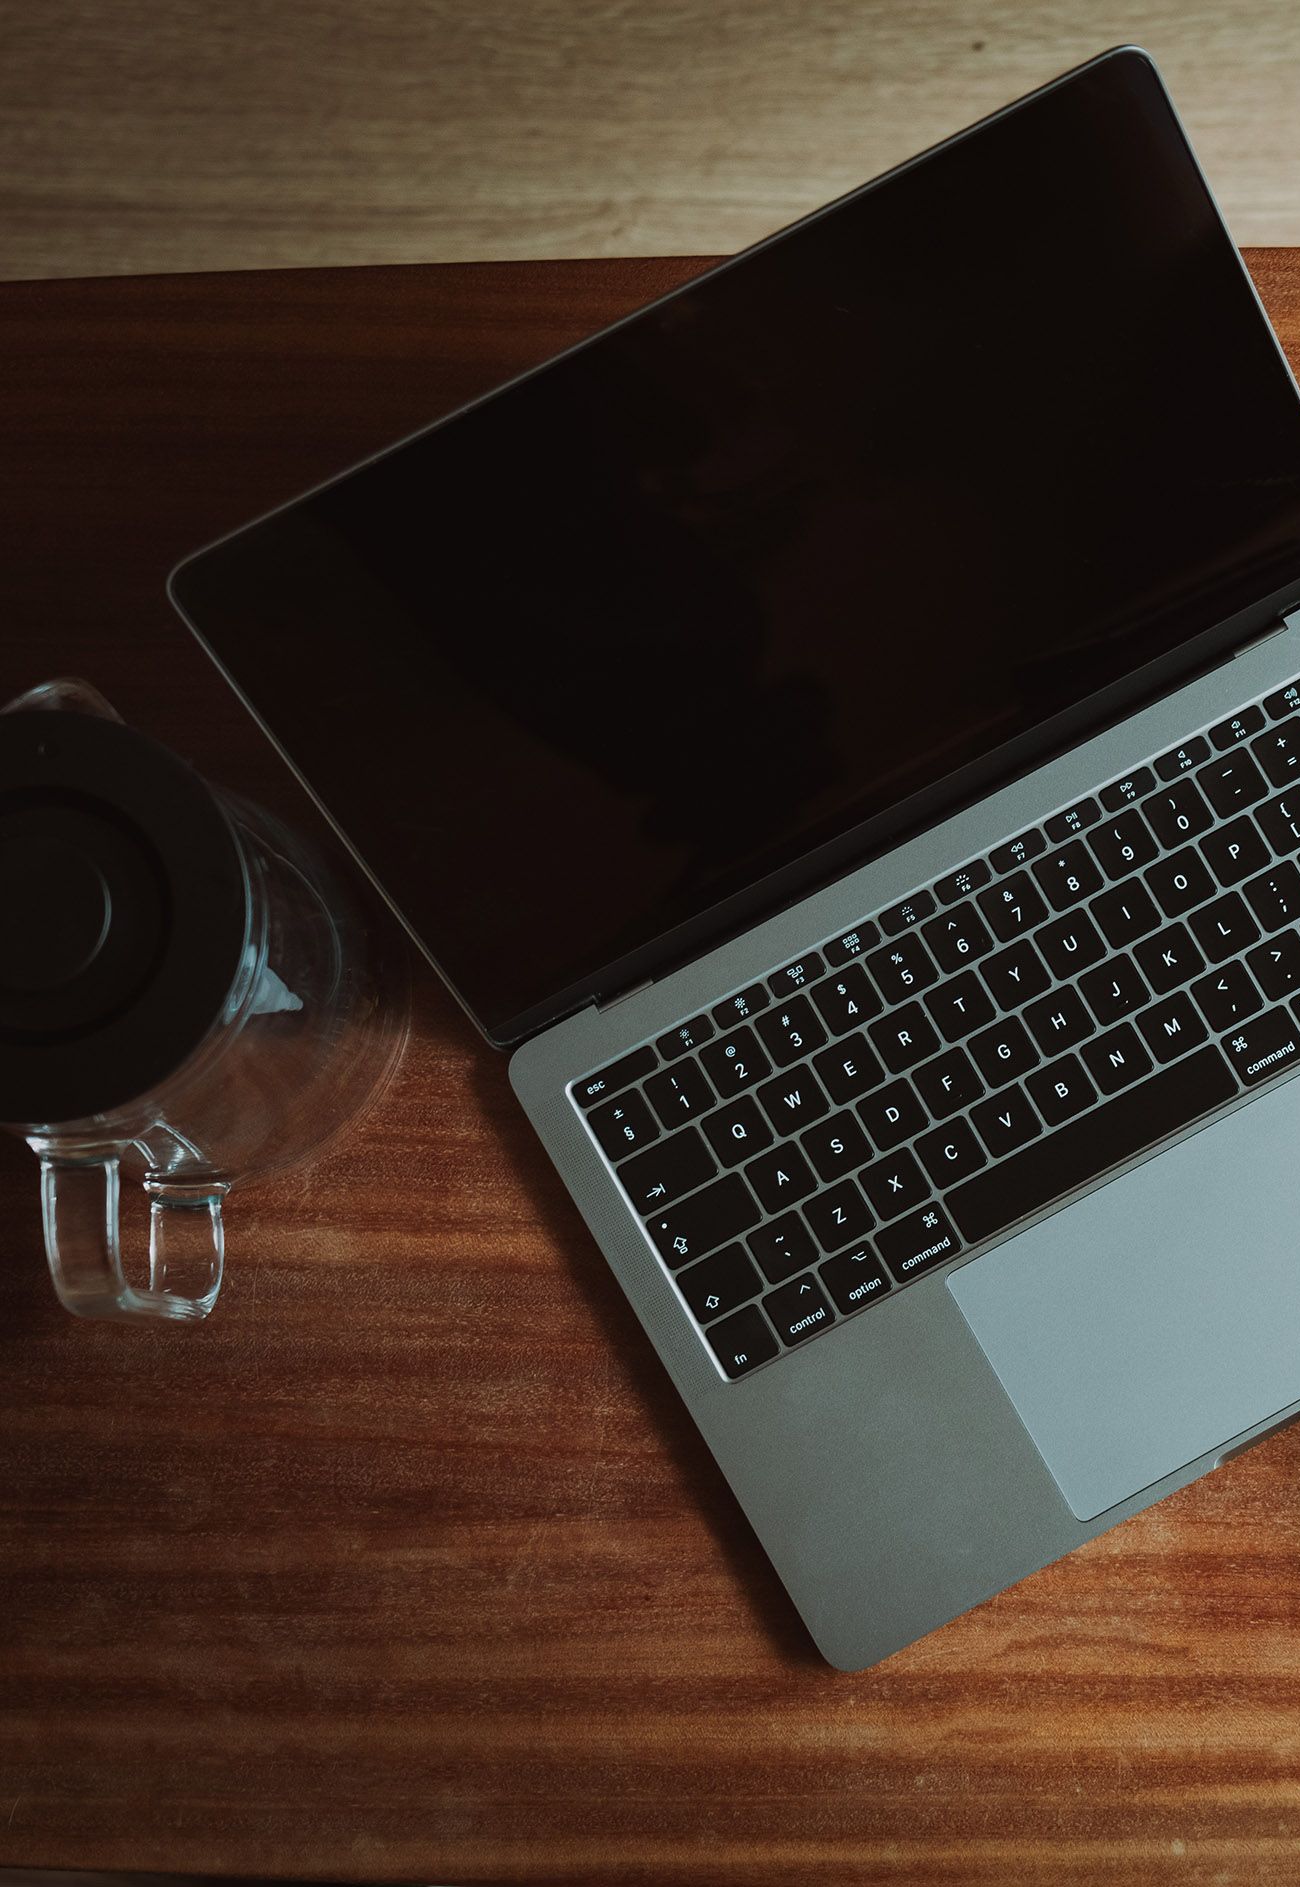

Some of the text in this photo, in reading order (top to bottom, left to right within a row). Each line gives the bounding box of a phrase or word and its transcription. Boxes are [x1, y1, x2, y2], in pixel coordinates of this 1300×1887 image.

[1289, 698, 1300, 708] F12
[1235, 729, 1246, 738] F11
[1180, 759, 1192, 768] F10
[1127, 791, 1135, 799] F9
[1071, 822, 1081, 830] F8
[1177, 815, 1189, 829] 0
[1017, 852, 1025, 860] F7
[1122, 846, 1134, 860] 9
[1228, 844, 1239, 859] P
[961, 884, 971, 892] F6
[1067, 876, 1080, 891] 8
[1174, 875, 1187, 889] O
[906, 914, 916, 923] F5
[1011, 906, 1021, 922] 7
[1122, 906, 1130, 919] I
[1217, 922, 1231, 935] L
[850, 944, 861, 954] F4
[957, 938, 969, 953] 6
[1063, 935, 1077, 951] U
[1162, 950, 1177, 966] K
[794, 975, 805, 985] F3
[901, 969, 913, 984] 5
[1008, 967, 1020, 982] Y
[1113, 981, 1120, 997] J
[740, 1005, 750, 1016] F2
[848, 1000, 858, 1014] 4
[953, 997, 965, 1012] T
[1051, 1013, 1066, 1030] H
[1164, 1018, 1181, 1036] M
[684, 1036, 694, 1046] F1
[790, 1032, 802, 1047] 3
[898, 1031, 912, 1046] R
[998, 1044, 1011, 1059] G
[1109, 1050, 1125, 1067] N
[1247, 1041, 1296, 1075] command
[735, 1063, 748, 1078] 2
[843, 1061, 857, 1076] E
[587, 1081, 605, 1095] esc
[942, 1075, 952, 1091] F
[1054, 1083, 1068, 1098] B
[680, 1095, 689, 1108] 1
[784, 1091, 801, 1108] W
[885, 1107, 899, 1122] D
[998, 1112, 1011, 1127] V
[732, 1124, 747, 1139] Q
[830, 1139, 844, 1153] S
[945, 1145, 958, 1160] C
[777, 1170, 790, 1186] A
[888, 1175, 903, 1192] X
[832, 1207, 847, 1224] Z
[902, 1237, 951, 1271] command
[849, 1278, 883, 1302] option
[790, 1307, 825, 1334] control
[735, 1354, 747, 1365] fn
